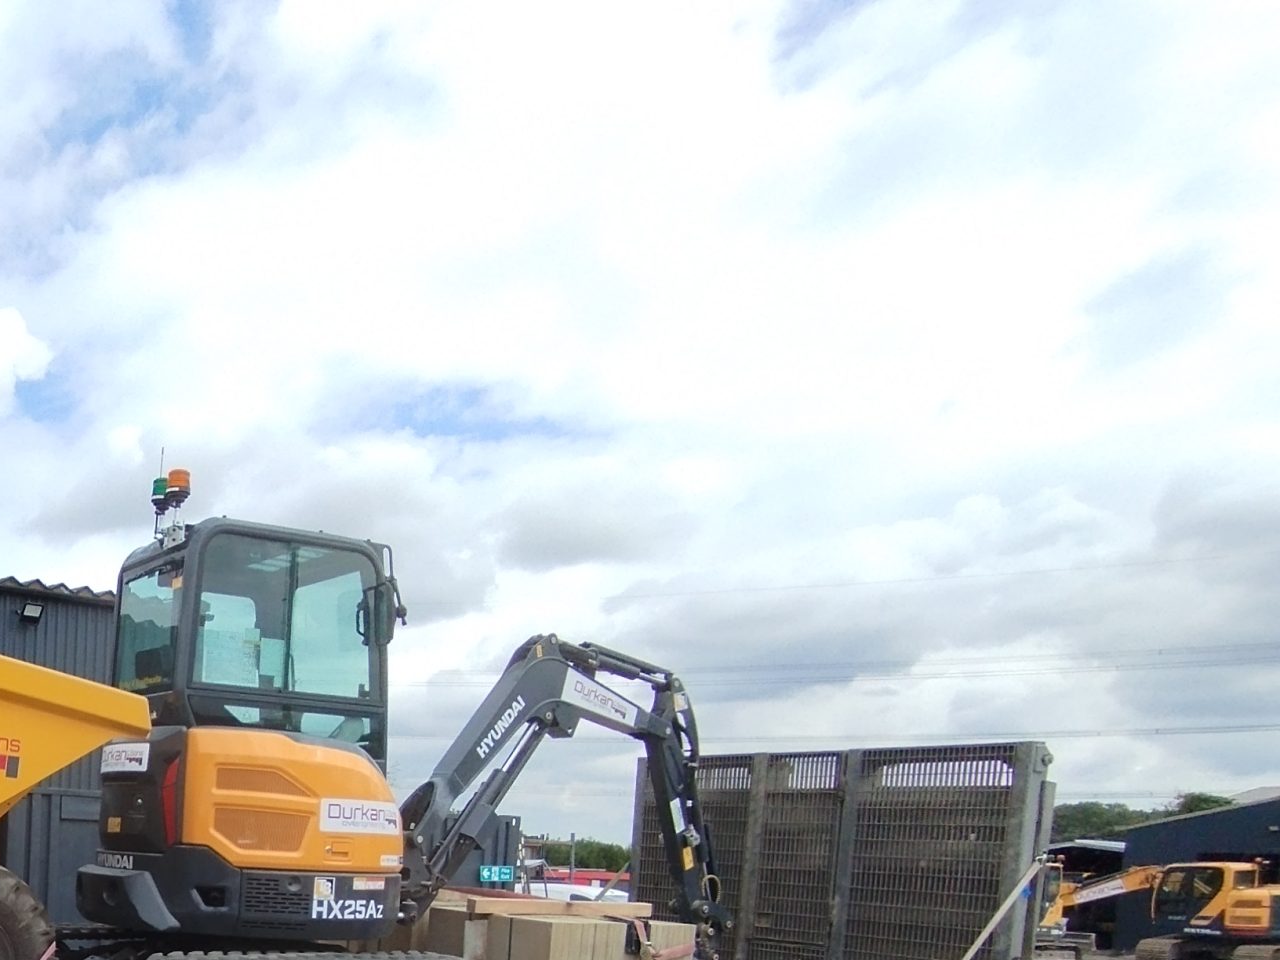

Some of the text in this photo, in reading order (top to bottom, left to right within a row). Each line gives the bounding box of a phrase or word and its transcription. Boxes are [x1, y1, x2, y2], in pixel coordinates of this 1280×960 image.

[574, 680, 614, 709] Durkan
[476, 695, 527, 759] HYUNDAI
[328, 804, 385, 821] Durkan
